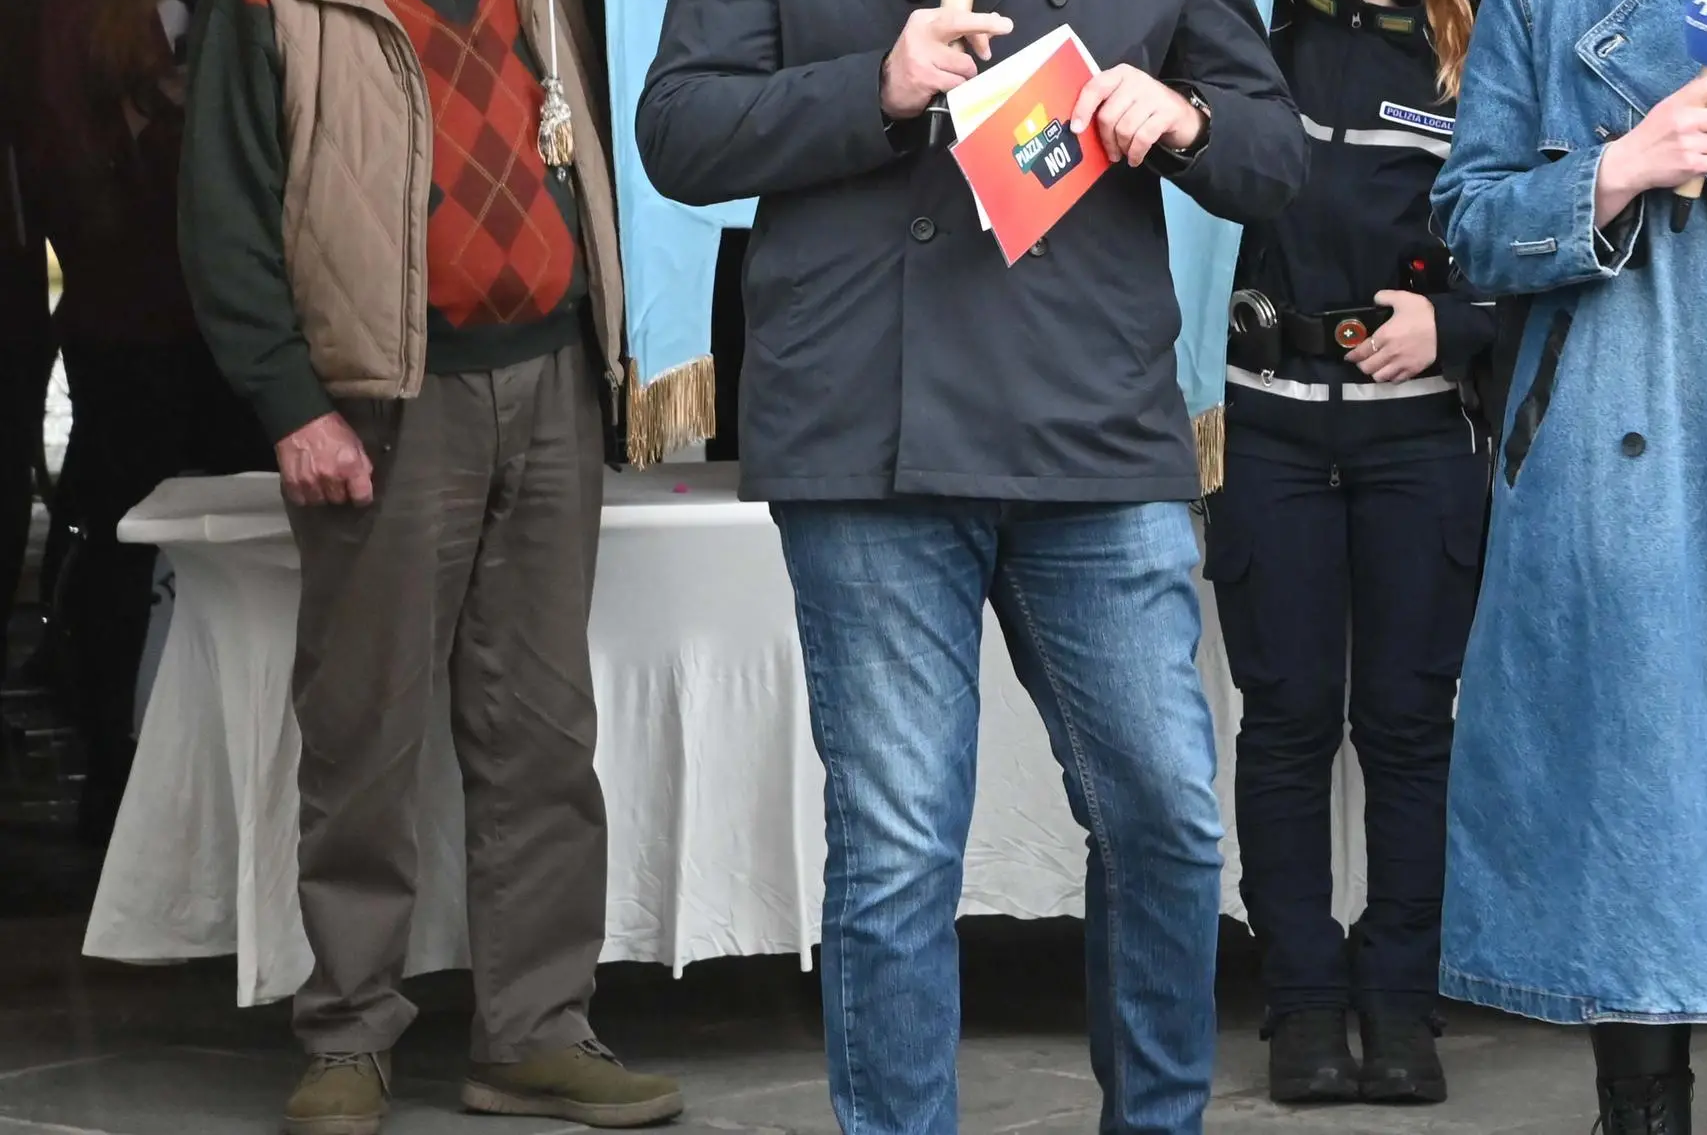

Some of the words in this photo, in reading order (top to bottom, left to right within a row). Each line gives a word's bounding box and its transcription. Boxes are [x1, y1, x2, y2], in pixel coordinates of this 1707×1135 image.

[1386, 107, 1422, 123] POLIZIA
[1423, 118, 1456, 130] LOCAL
[1015, 136, 1044, 168] PIAZZA
[1044, 142, 1072, 177] NOI
